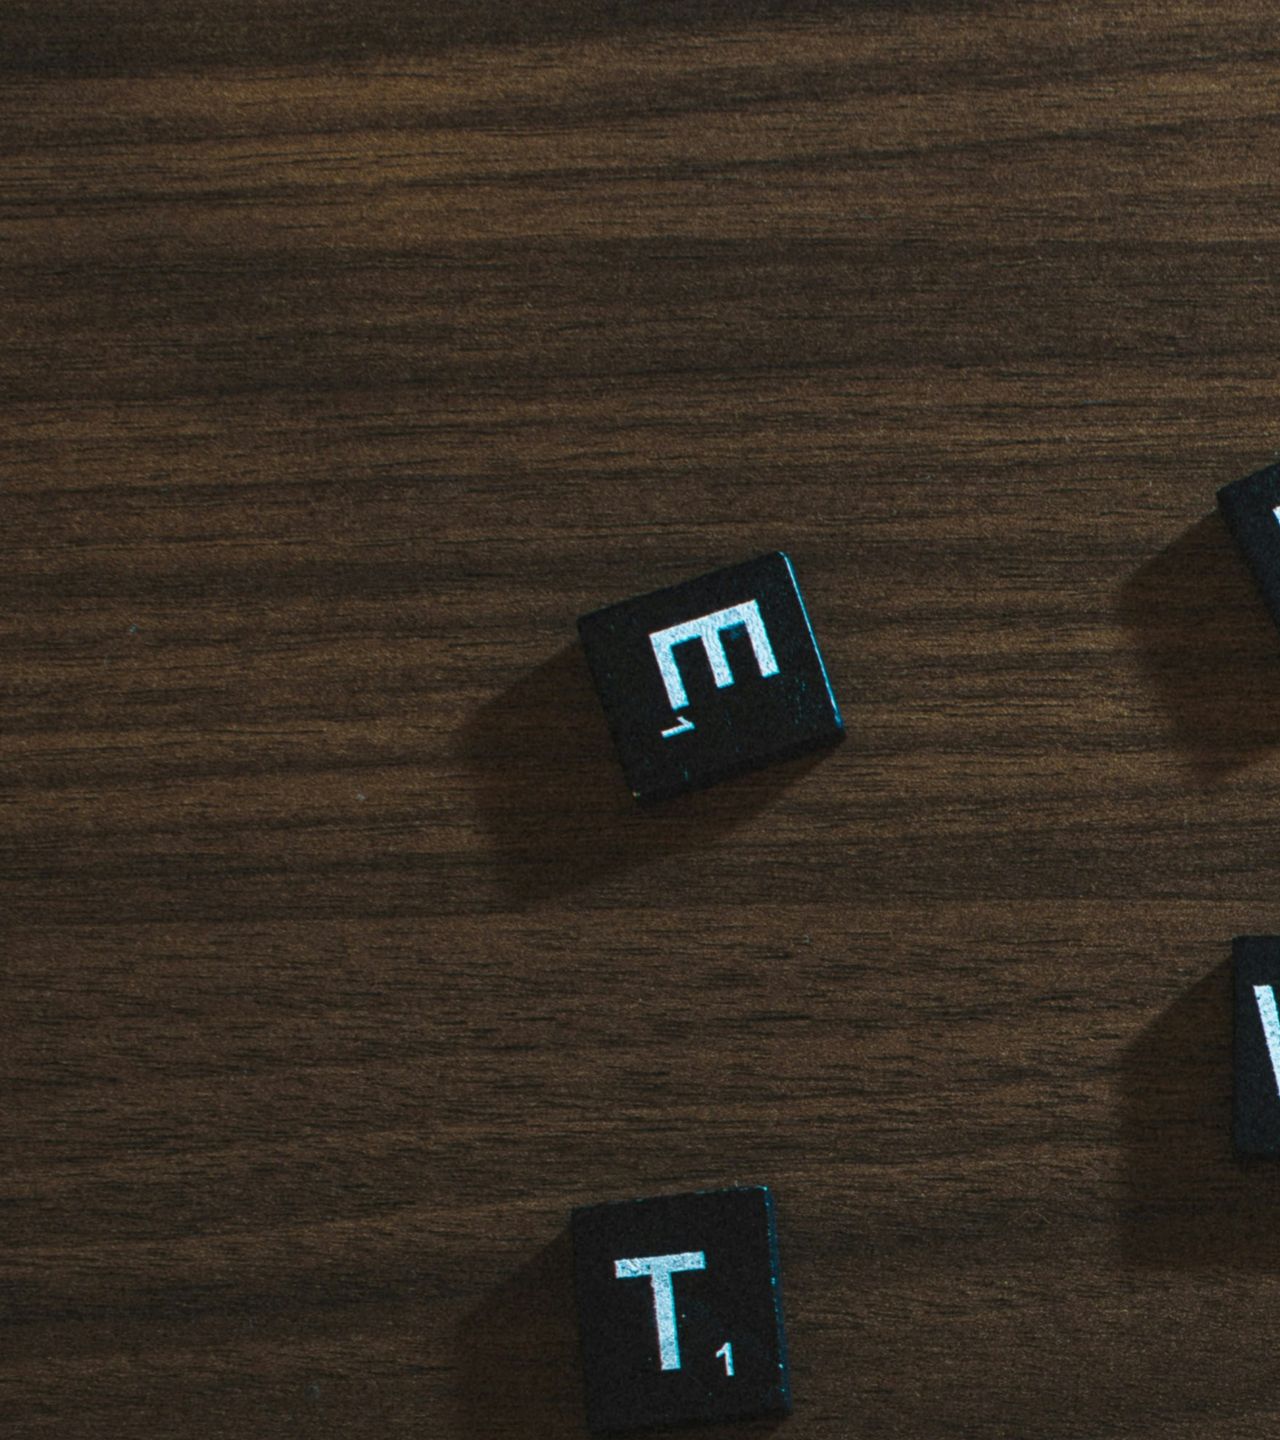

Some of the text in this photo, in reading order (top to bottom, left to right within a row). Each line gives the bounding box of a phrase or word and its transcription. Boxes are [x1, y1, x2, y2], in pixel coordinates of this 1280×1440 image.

[649, 600, 777, 708] E
[661, 716, 692, 737] 1
[614, 1252, 703, 1371] T
[715, 1343, 732, 1376] 1
